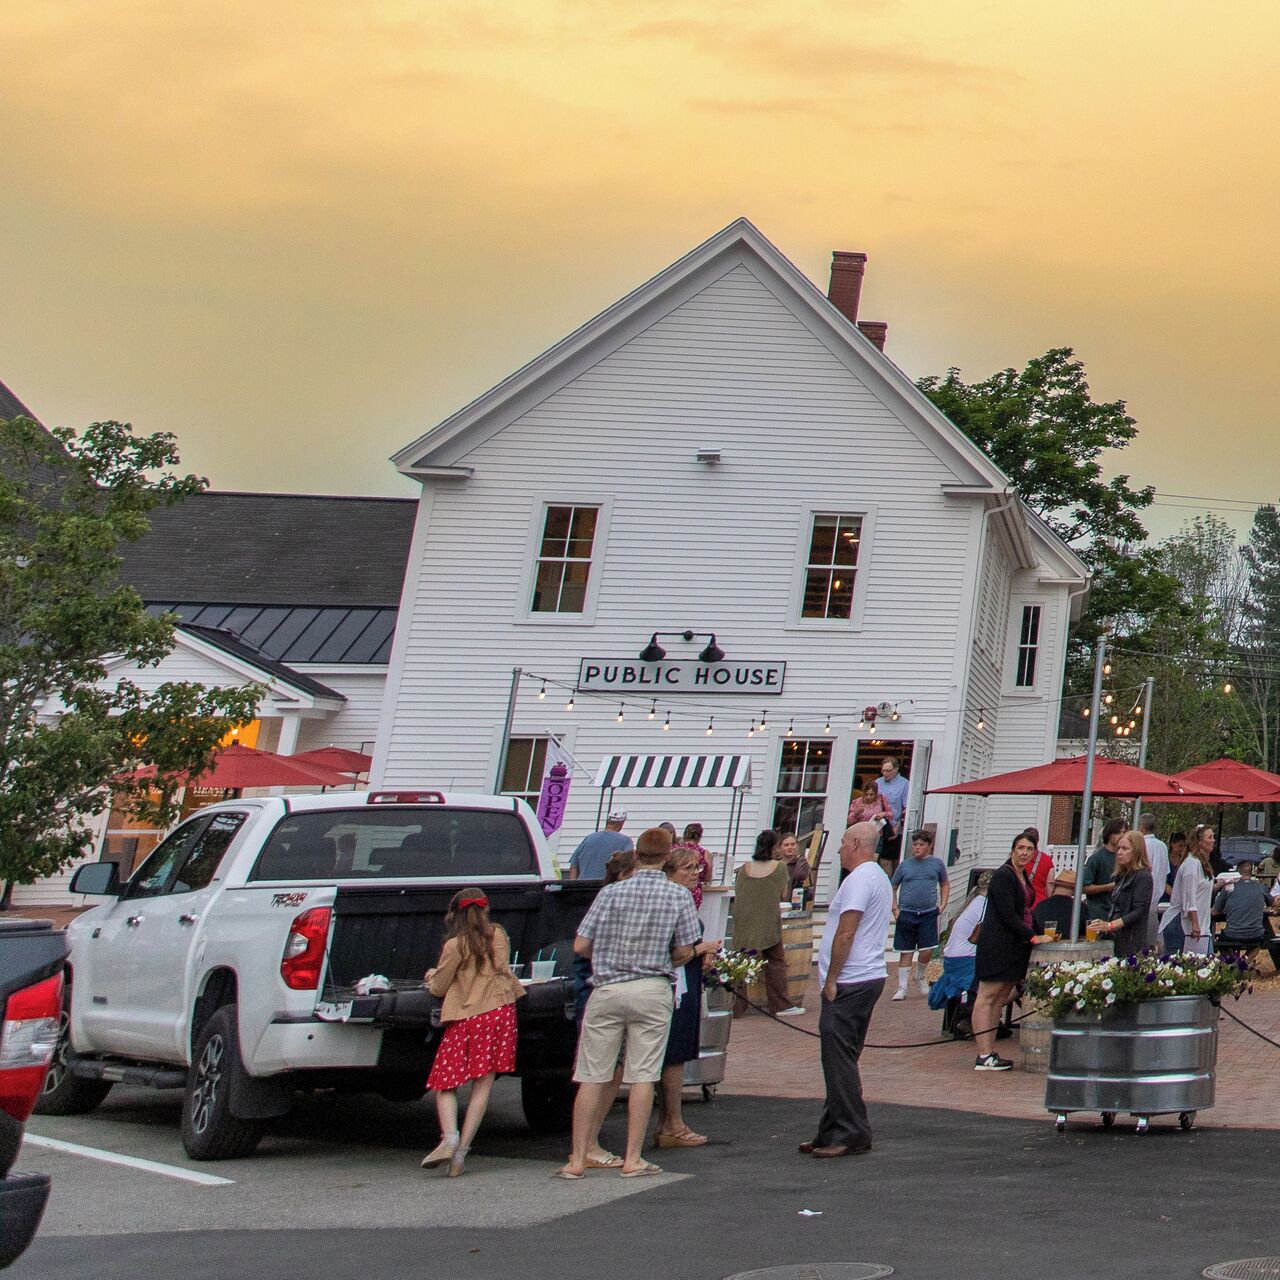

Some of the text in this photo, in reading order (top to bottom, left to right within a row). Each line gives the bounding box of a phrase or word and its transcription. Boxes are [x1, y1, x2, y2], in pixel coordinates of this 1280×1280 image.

[584, 665, 779, 686] PUBLIC HOUSE
[542, 783, 563, 830] OPEN
